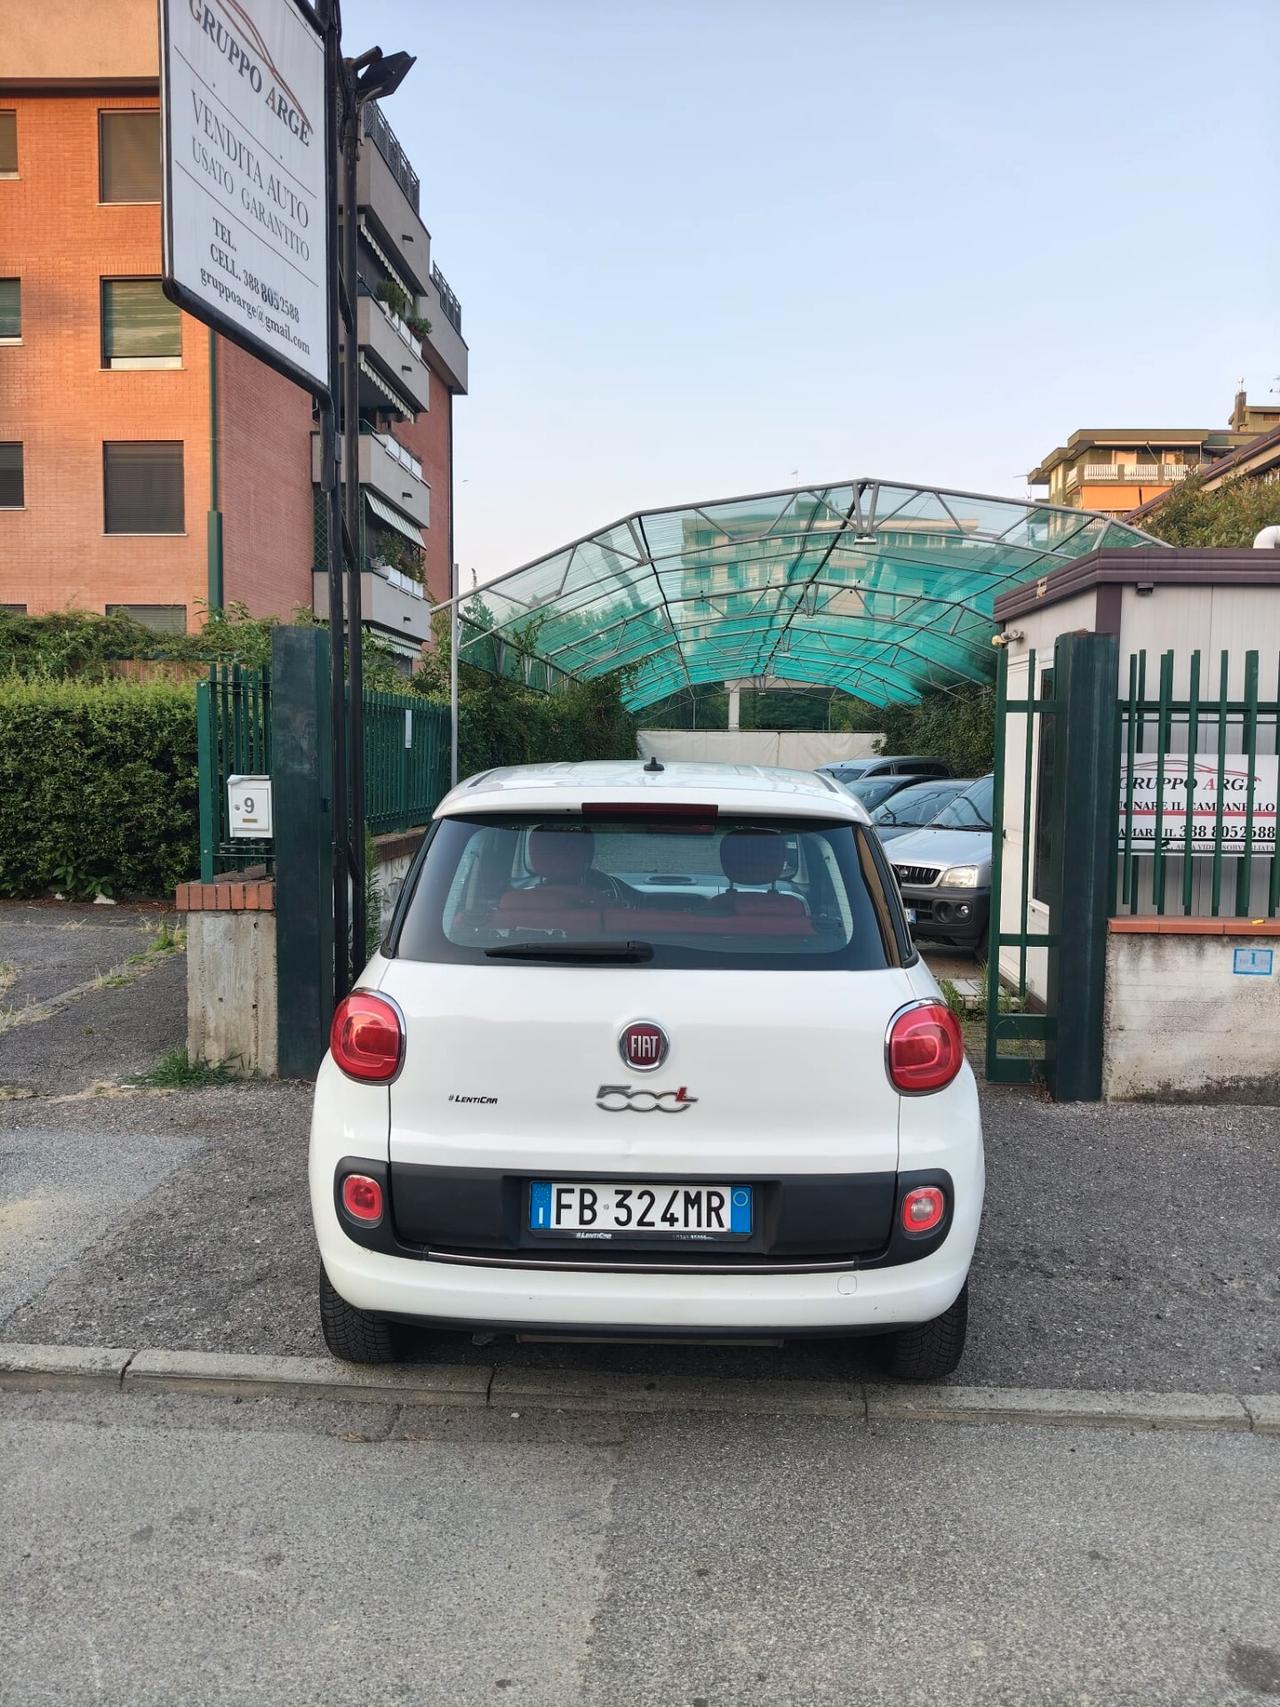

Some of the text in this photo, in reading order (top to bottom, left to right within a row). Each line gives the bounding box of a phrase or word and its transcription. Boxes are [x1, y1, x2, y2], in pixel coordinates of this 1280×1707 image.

[189, 0, 311, 147] GRUPPO ARGE
[191, 89, 309, 229] VENDITA AUTO
[192, 136, 310, 262] USATO GARANTITO
[212, 216, 237, 252] TEL.
[210, 243, 242, 281] CELL.
[200, 267, 311, 356] gruppoarge@gmail.com
[1120, 777, 1198, 790] GRUPPO
[244, 797, 255, 814] 9
[1172, 802, 1185, 811] IL
[1164, 829, 1177, 837] IL
[631, 1035, 659, 1058] FIAT
[596, 1085, 699, 1113] 500L
[555, 1188, 598, 1226] FB
[613, 1189, 726, 1228] 324MR
